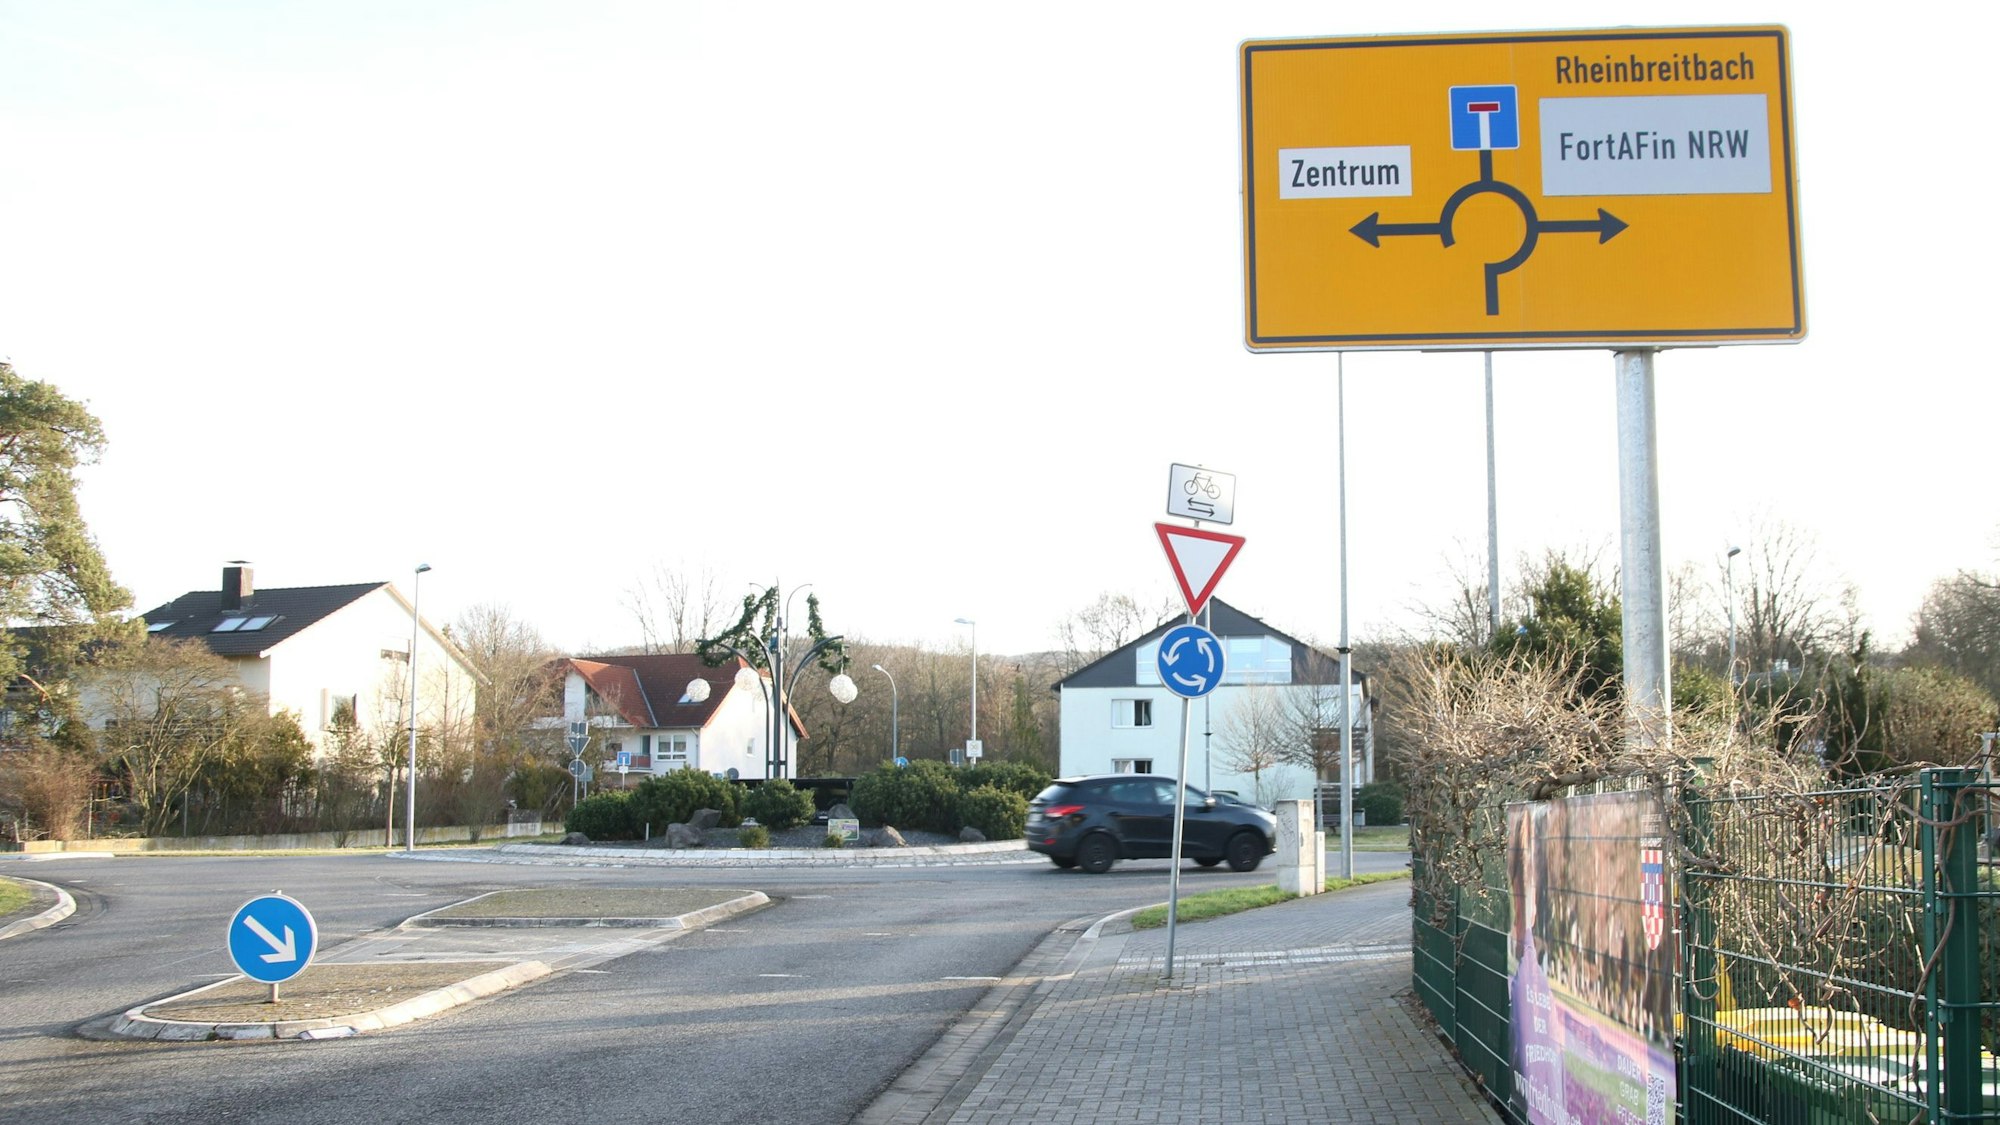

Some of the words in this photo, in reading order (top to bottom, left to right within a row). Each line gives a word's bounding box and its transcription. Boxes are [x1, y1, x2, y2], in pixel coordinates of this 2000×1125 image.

[1556, 52, 1755, 84] Rheinbreitbach
[1560, 131, 1676, 161] FortAFin
[1688, 129, 1749, 159] NRW
[1291, 159, 1400, 188] Zentrum
